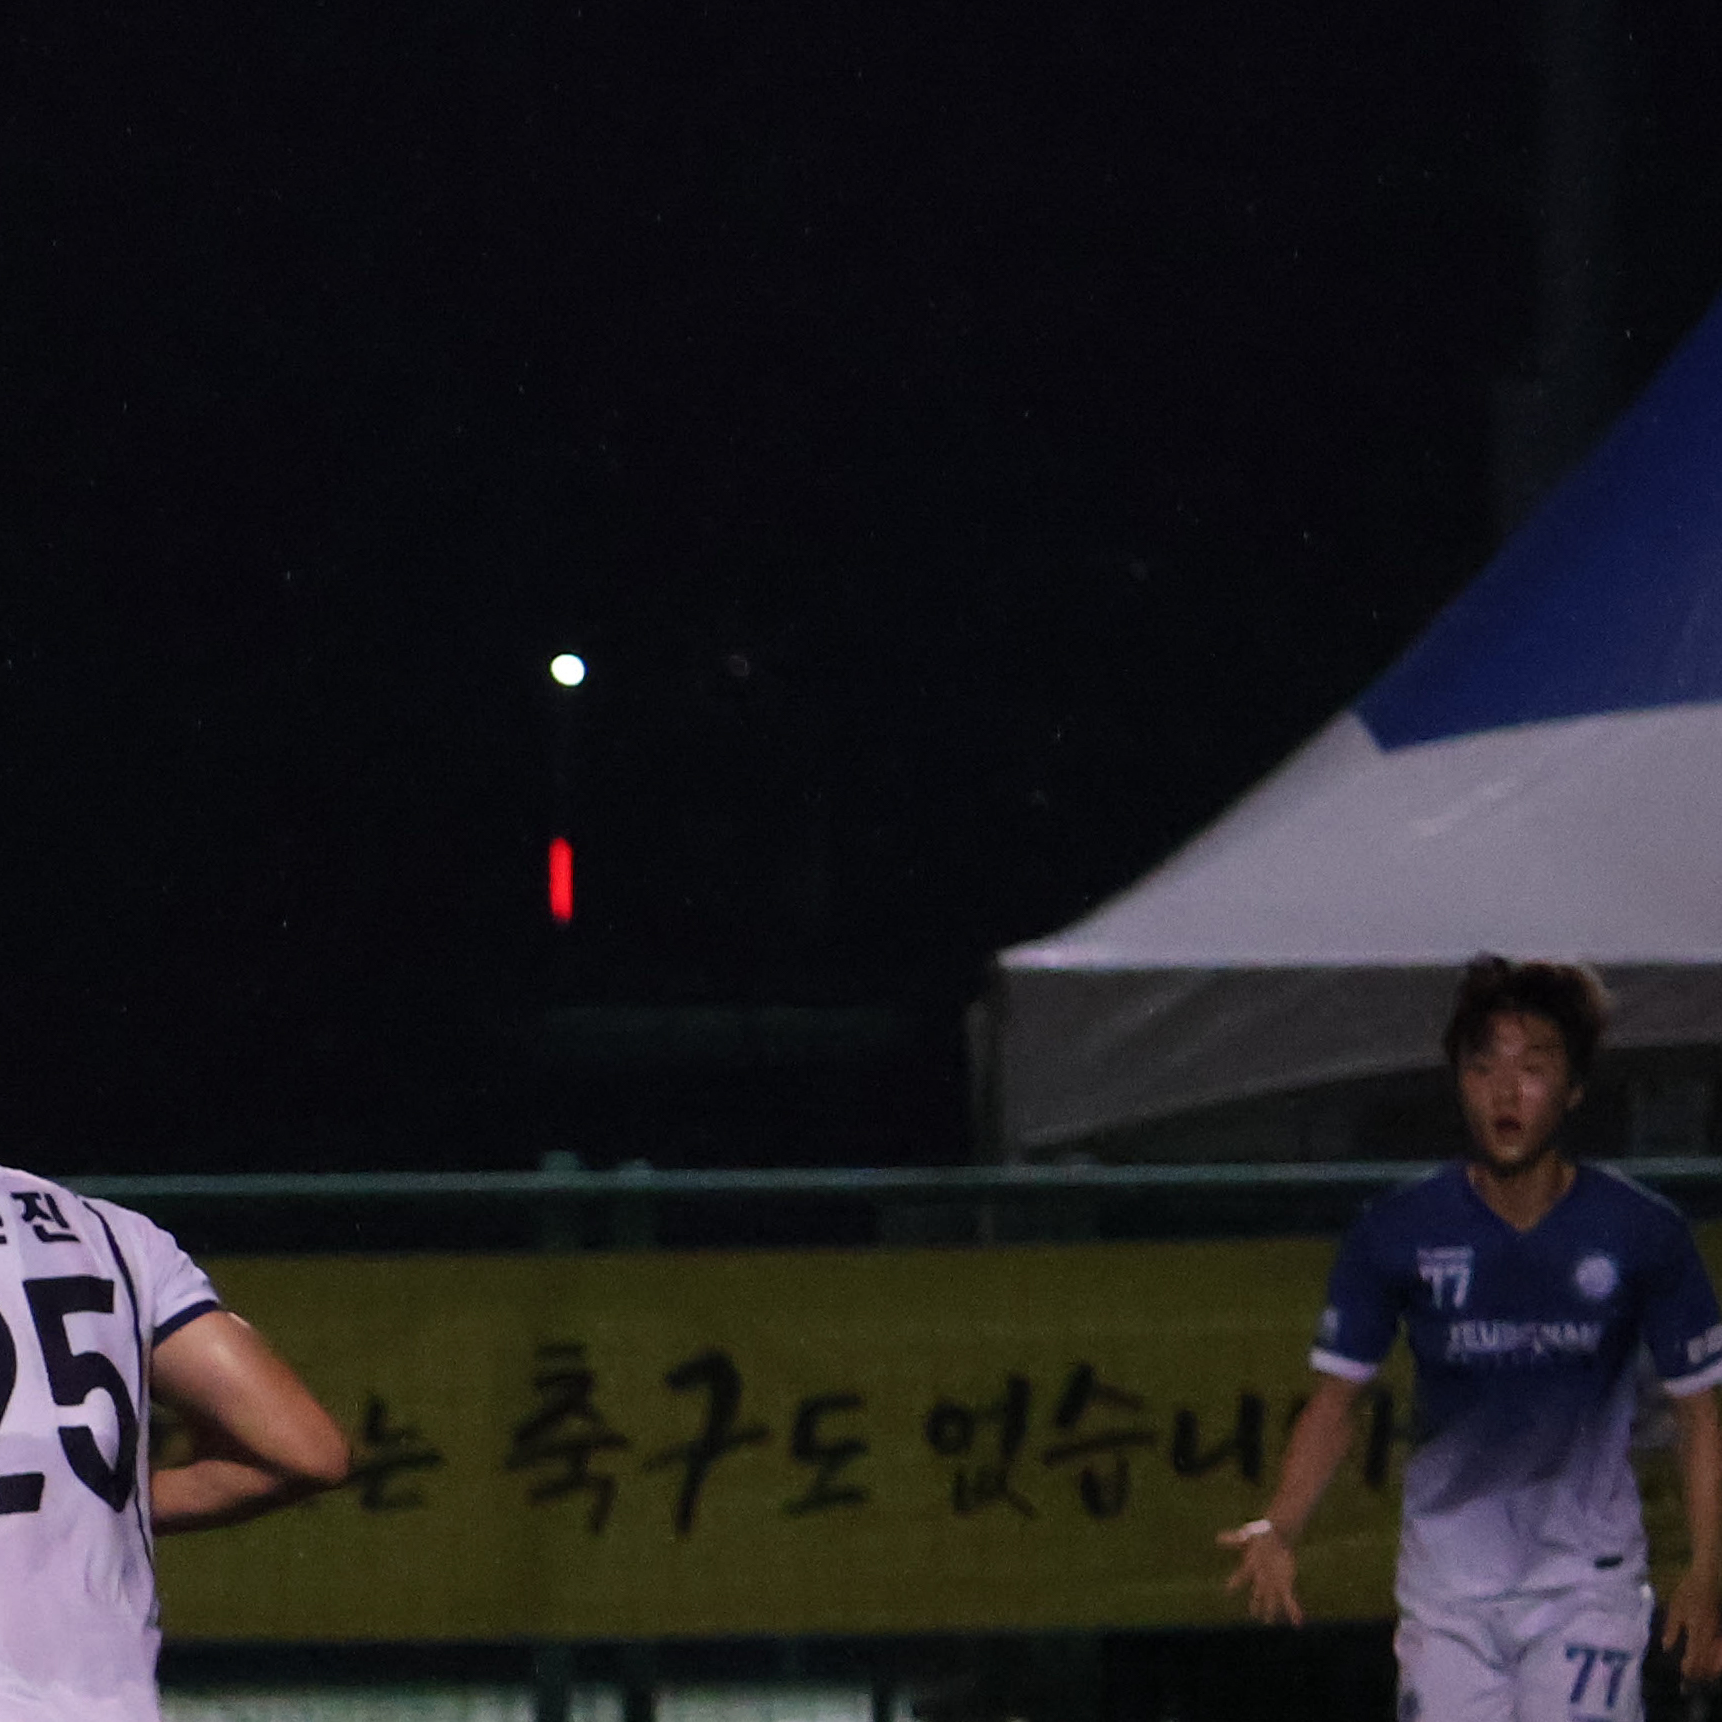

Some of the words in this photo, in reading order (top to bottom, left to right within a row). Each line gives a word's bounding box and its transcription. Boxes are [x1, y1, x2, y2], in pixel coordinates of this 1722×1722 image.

[1416, 1254, 1473, 1310] 77
[504, 1342, 869, 1535] 축구도
[1565, 1645, 1632, 1709] 77
